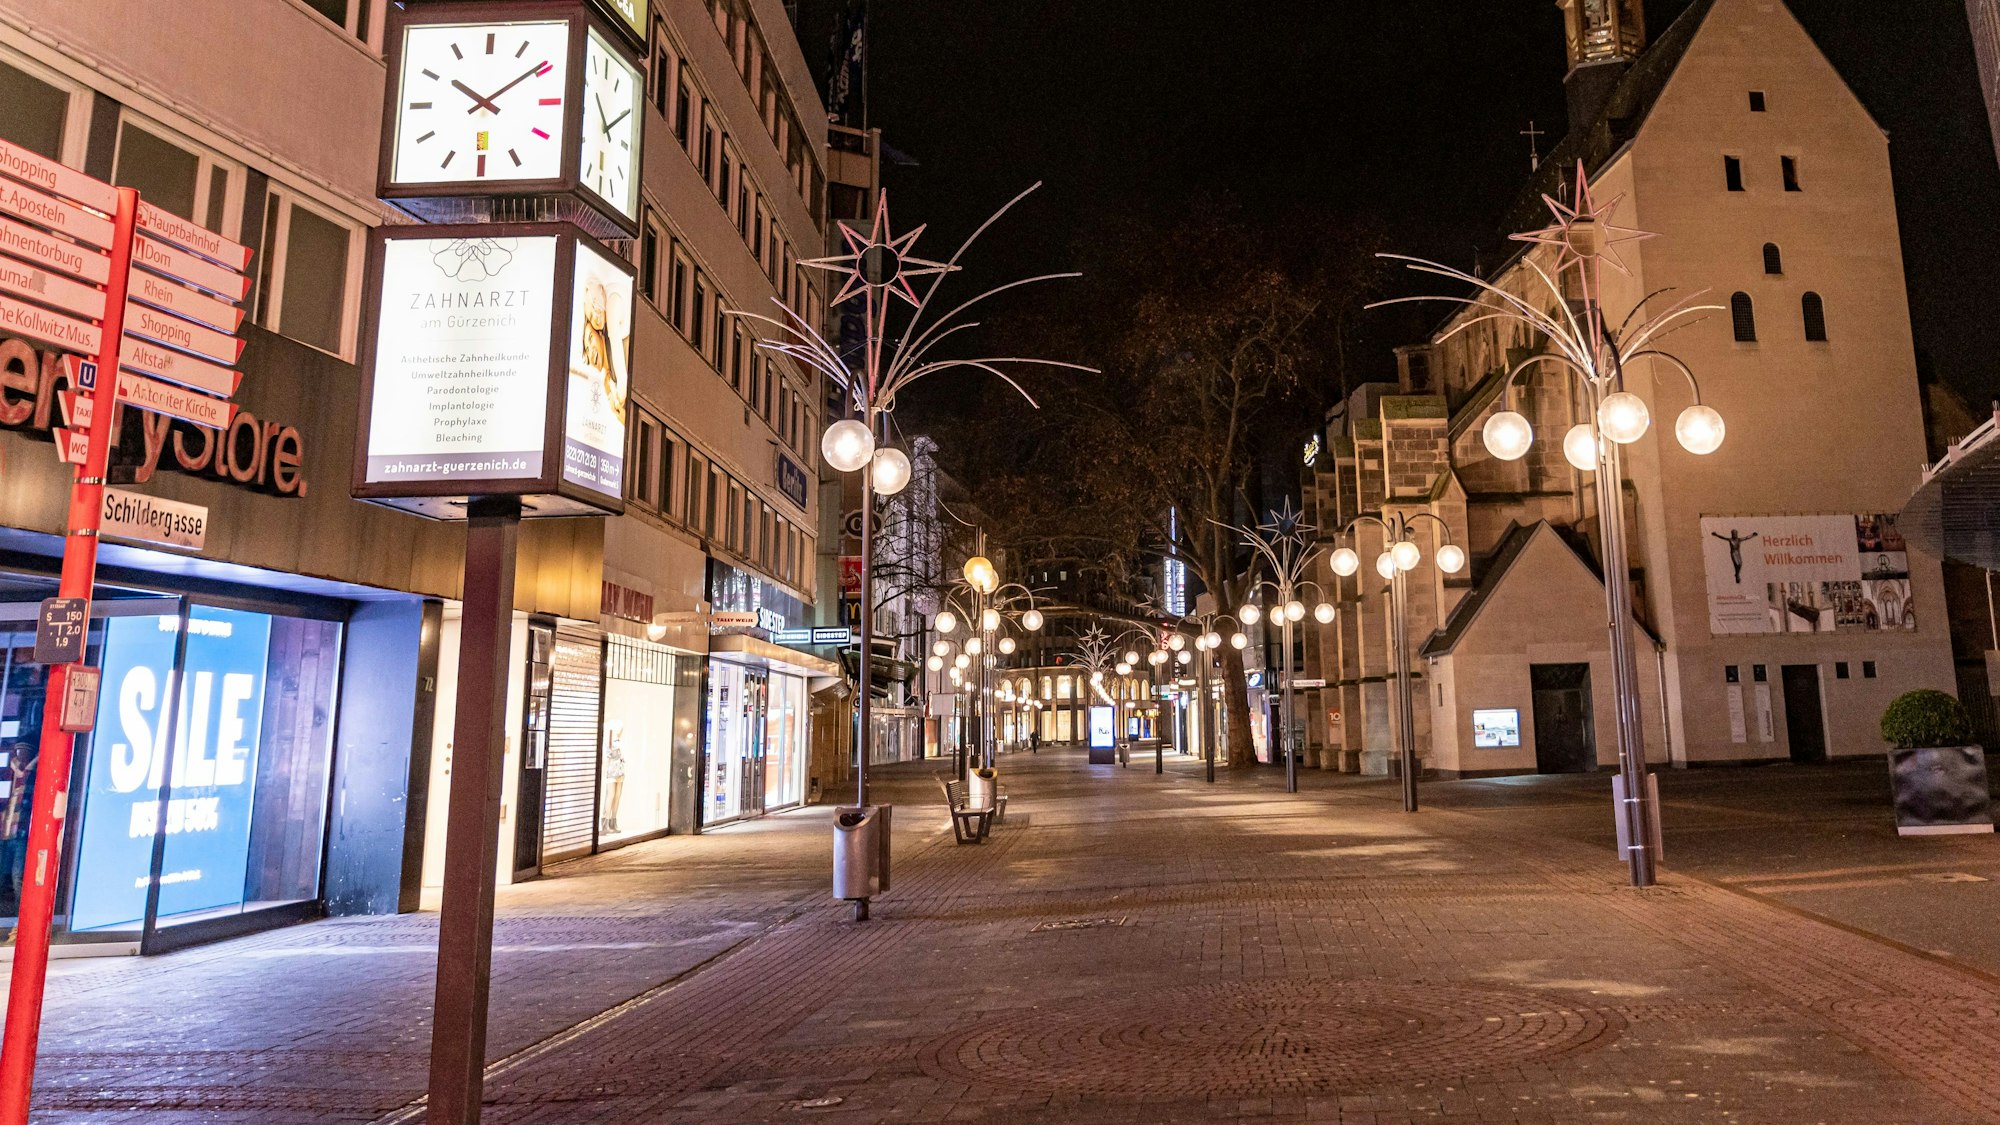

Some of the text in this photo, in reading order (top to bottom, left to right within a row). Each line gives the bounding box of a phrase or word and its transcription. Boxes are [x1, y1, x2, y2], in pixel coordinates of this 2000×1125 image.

[9, 190, 65, 225] Aposteln
[148, 211, 220, 254] Hauptbahnhof
[0, 225, 82, 273] hnentorburg
[145, 244, 171, 267] Dom
[144, 280, 173, 304] Rhein
[410, 290, 529, 309] ZAHNARZT
[16, 308, 64, 338] Kollwitz
[66, 324, 93, 348] Mus.
[421, 313, 516, 328] am Gürzenich
[141, 313, 191, 347] Shopping
[132, 347, 174, 369] Altsta
[460, 352, 530, 363] Zahnheilkunde
[82, 366, 93, 384] U
[411, 369, 517, 379] Umweltzahnheilkunde
[427, 385, 499, 395] Parodontologie
[76, 406, 91, 418] TAXI
[186, 397, 217, 419] Kirche
[429, 401, 495, 412] Implantologie
[434, 416, 487, 427] Prophylaxe
[436, 433, 482, 443] Bleaching
[71, 443, 87, 455] WC
[384, 458, 527, 474] zahnarzt-guerzenich.de
[104, 494, 202, 538] Schildergasse
[1762, 534, 1813, 547] Herzlich
[1764, 552, 1842, 565] Willkommen
[47, 611, 82, 621] S 150
[66, 625, 80, 635] 2.0
[815, 632, 847, 640] SIDESTEP
[55, 637, 69, 647] 1,9
[110, 666, 253, 793] SALE
